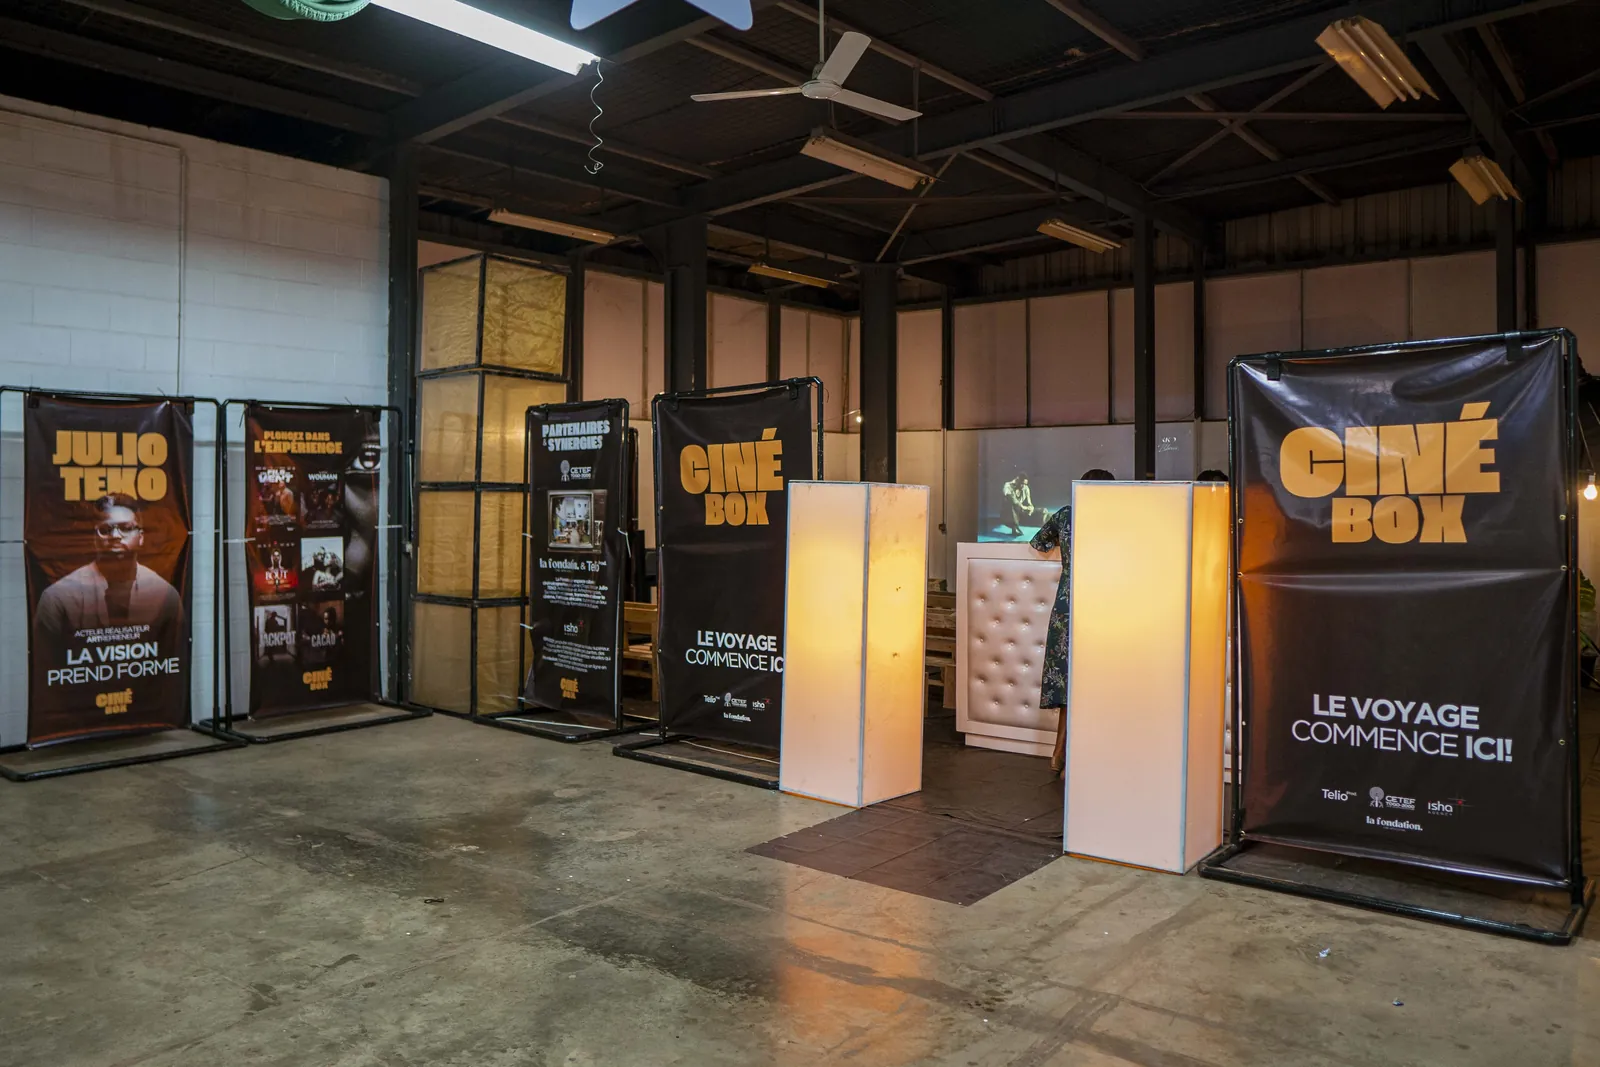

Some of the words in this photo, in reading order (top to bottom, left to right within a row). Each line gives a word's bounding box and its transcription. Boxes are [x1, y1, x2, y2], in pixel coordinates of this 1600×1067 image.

[264, 430, 304, 441] PLONGEZ
[305, 431, 330, 441] DANS
[542, 419, 610, 438] PARTENAIRES
[52, 430, 168, 467] JULIO
[254, 439, 343, 454] L'EXPÉRIENCE
[547, 435, 603, 452] SYNERGIES
[1280, 401, 1500, 498] CINÉ
[570, 466, 592, 474] CETEF
[680, 427, 784, 494] CINÉ
[60, 467, 167, 501] TEKO
[704, 492, 769, 526] BOX
[1331, 495, 1467, 544] BOX
[539, 557, 548, 569] la
[580, 561, 586, 571] &
[105, 625, 152, 635] RÉALISATEUR
[311, 633, 336, 648] CACAO
[697, 630, 714, 647] LE
[715, 631, 777, 652] VOYAGE
[67, 647, 93, 665] LA
[96, 641, 158, 662] VISION
[685, 648, 768, 671] COMMENCE
[770, 655, 784, 673] IC
[47, 665, 114, 686] PREND
[117, 657, 180, 680] FORME
[1313, 693, 1347, 718] LE
[1351, 696, 1480, 730] VOYAGE
[1291, 719, 1459, 758] COMMENCE
[1465, 735, 1513, 762] ICI!
[1321, 788, 1349, 801] Telio
[1385, 796, 1416, 805] CETEF
[1428, 800, 1454, 813] isha
[1366, 815, 1375, 825] la
[1376, 816, 1424, 831] fondation.
